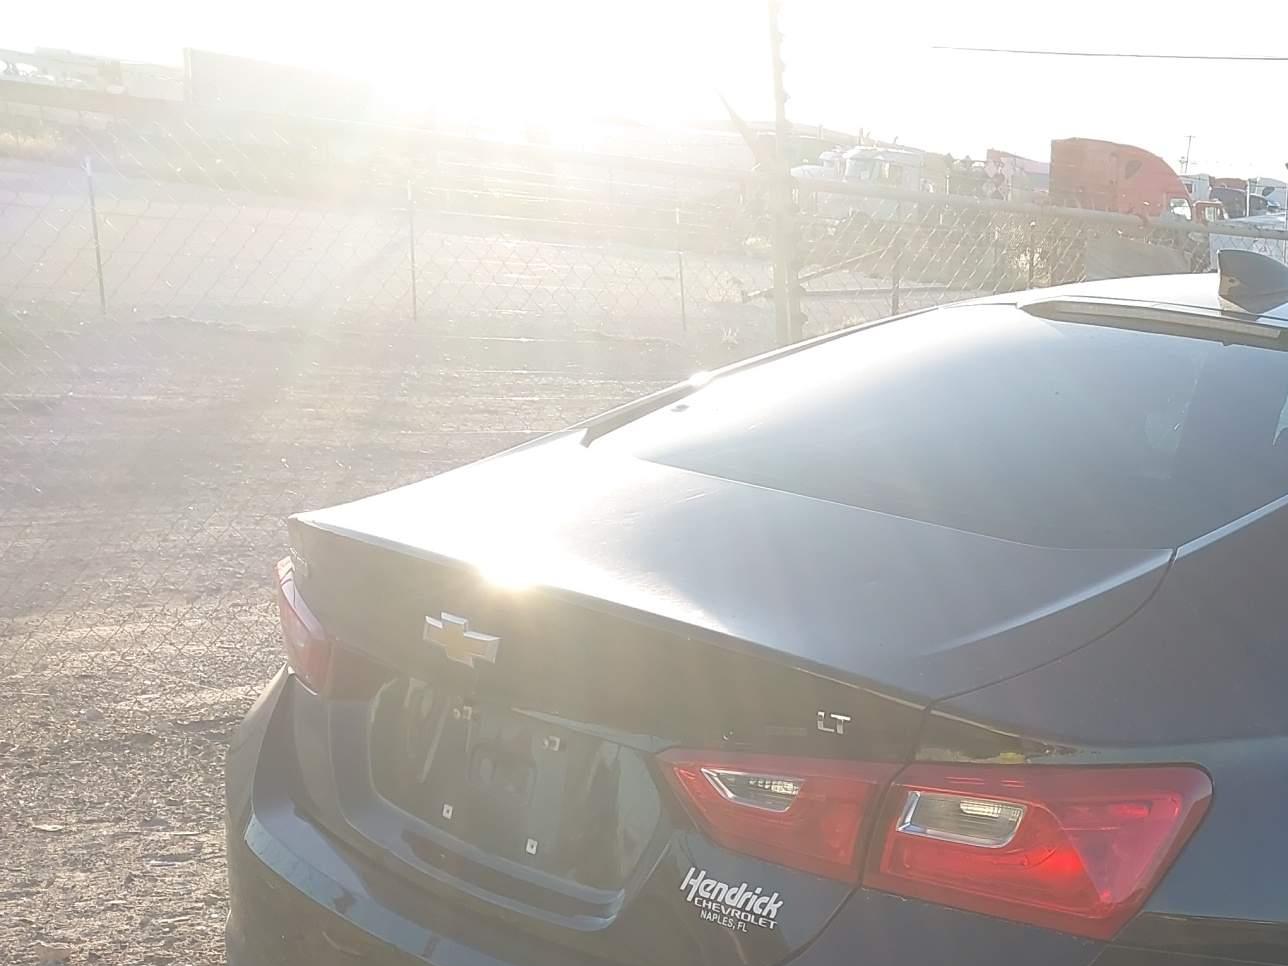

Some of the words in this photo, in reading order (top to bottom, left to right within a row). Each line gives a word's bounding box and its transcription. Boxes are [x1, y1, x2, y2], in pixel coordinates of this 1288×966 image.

[817, 711, 851, 734] LT
[680, 867, 784, 919] Hendrick
[694, 897, 778, 929] CHEVROLET
[700, 909, 736, 930] NAPLES,
[737, 921, 748, 932] FL
